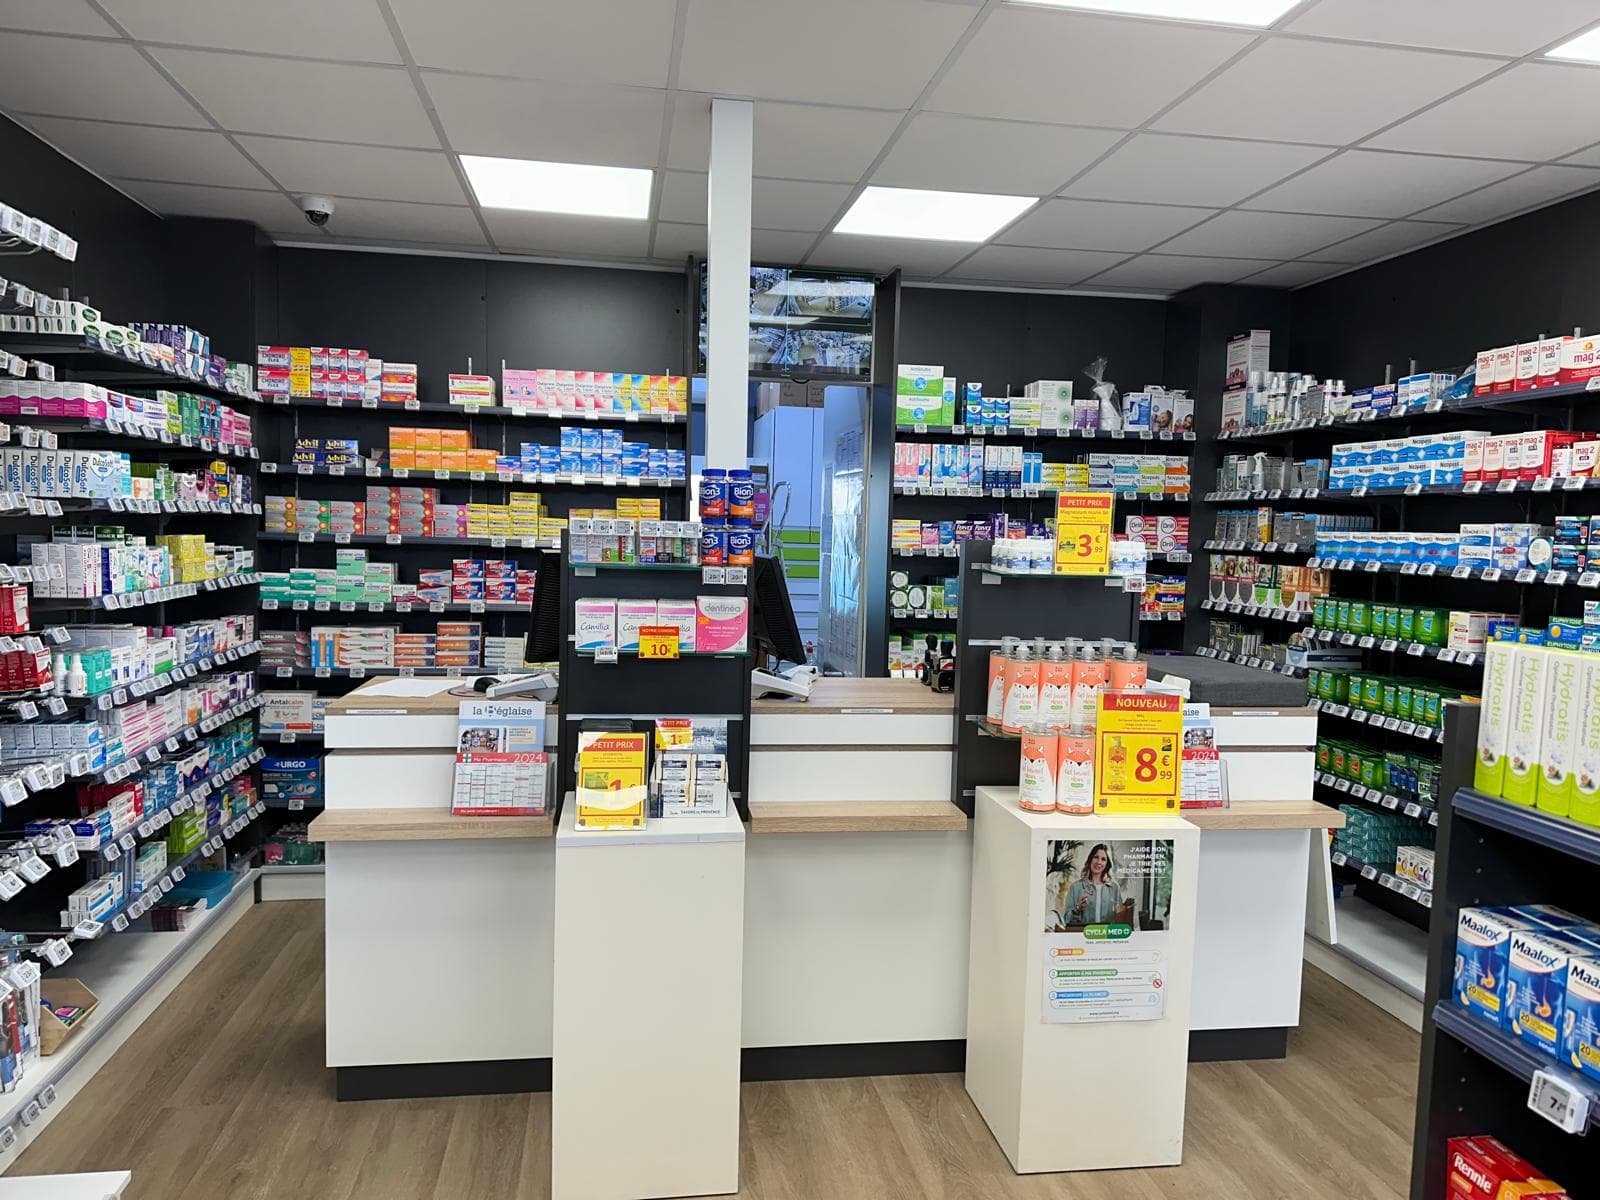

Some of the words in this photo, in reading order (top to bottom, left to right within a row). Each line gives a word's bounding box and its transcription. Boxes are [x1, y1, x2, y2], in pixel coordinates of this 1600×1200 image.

[1519, 348, 1532, 357] mag
[1541, 345, 1555, 353] mag
[1477, 356, 1490, 364] mag
[1496, 352, 1510, 360] mag
[1573, 352, 1594, 363] mag
[296, 439, 318, 447] Advil
[1465, 442, 1477, 450] mag
[1485, 441, 1498, 449] mag
[293, 452, 315, 460] Advil
[30, 455, 38, 492] DulcoSoft
[46, 456, 54, 493] DulcoSoft
[63, 456, 71, 493] DulcoSoft
[80, 456, 88, 493] DulcoSoft
[1162, 522, 1174, 530] Drill
[730, 534, 751, 545] Bion3
[1162, 540, 1174, 548] Drill
[1077, 534, 1092, 557] 3
[580, 621, 610, 632] Camilia
[651, 643, 668, 656] 10
[1490, 653, 1507, 727] Hydratis
[1520, 656, 1539, 734] Hydratis
[1115, 698, 1167, 709] NOUVEAU
[1556, 662, 1575, 742] Hydratis
[593, 741, 614, 749] PETIT
[615, 741, 635, 749] PRIX
[514, 753, 544, 763] 2024
[1191, 750, 1217, 760] 2024
[280, 760, 306, 769] URGO
[1135, 747, 1158, 783] 8
[1162, 755, 1171, 767] €
[1160, 770, 1172, 780] 99
[1460, 914, 1501, 942] Maalox
[1512, 939, 1559, 969] Maalox
[1570, 965, 1600, 990] Maa
[1467, 983, 1477, 995] 20
[1520, 1011, 1530, 1024] 20
[1580, 1043, 1591, 1056] 20
[1453, 1153, 1492, 1194] Rennie
